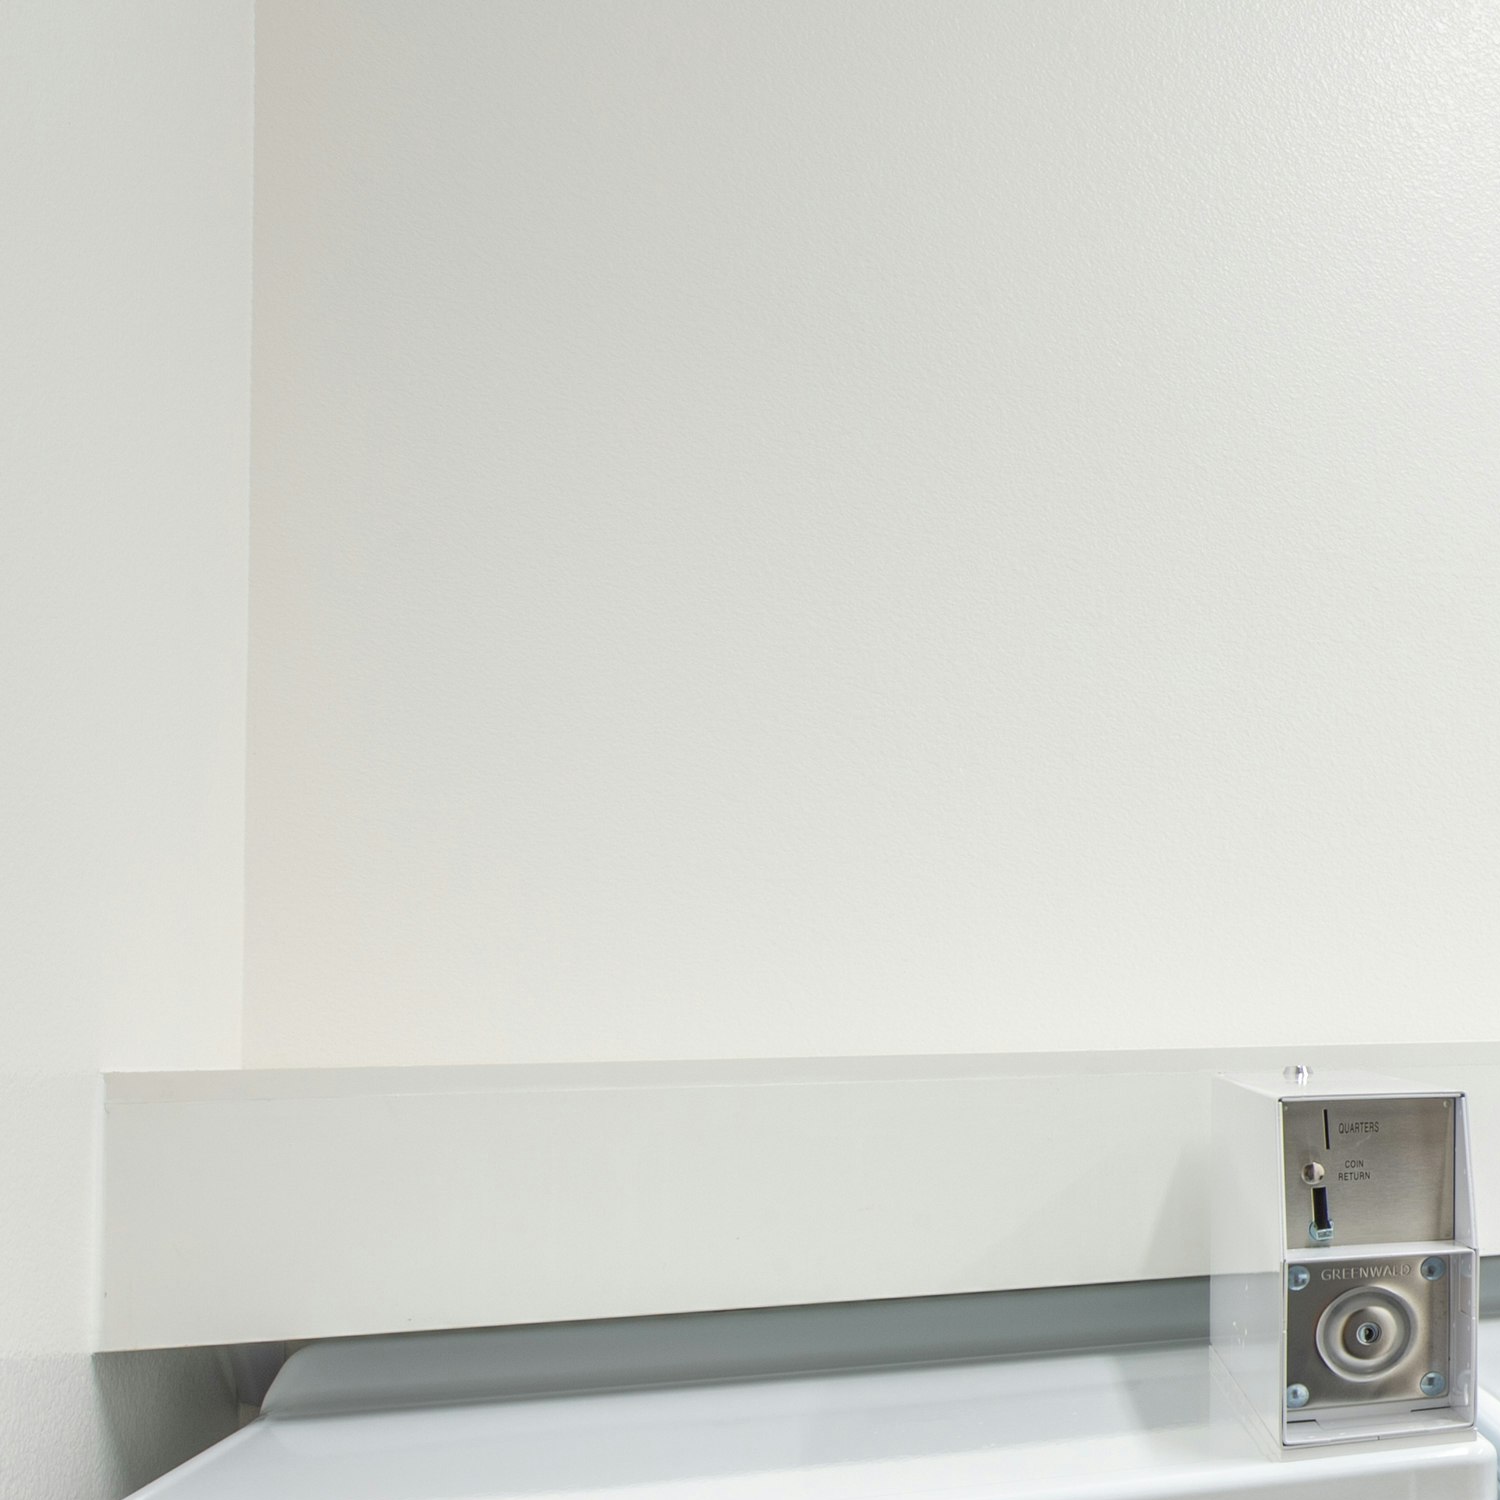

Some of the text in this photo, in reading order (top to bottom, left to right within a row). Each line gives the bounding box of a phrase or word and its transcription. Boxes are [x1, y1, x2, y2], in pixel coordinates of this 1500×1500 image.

[1338, 1122, 1380, 1134] QUARTERS
[1344, 1160, 1364, 1169] COIN
[1338, 1172, 1371, 1181] RETURN
[1321, 1264, 1412, 1281] GREENWALD
